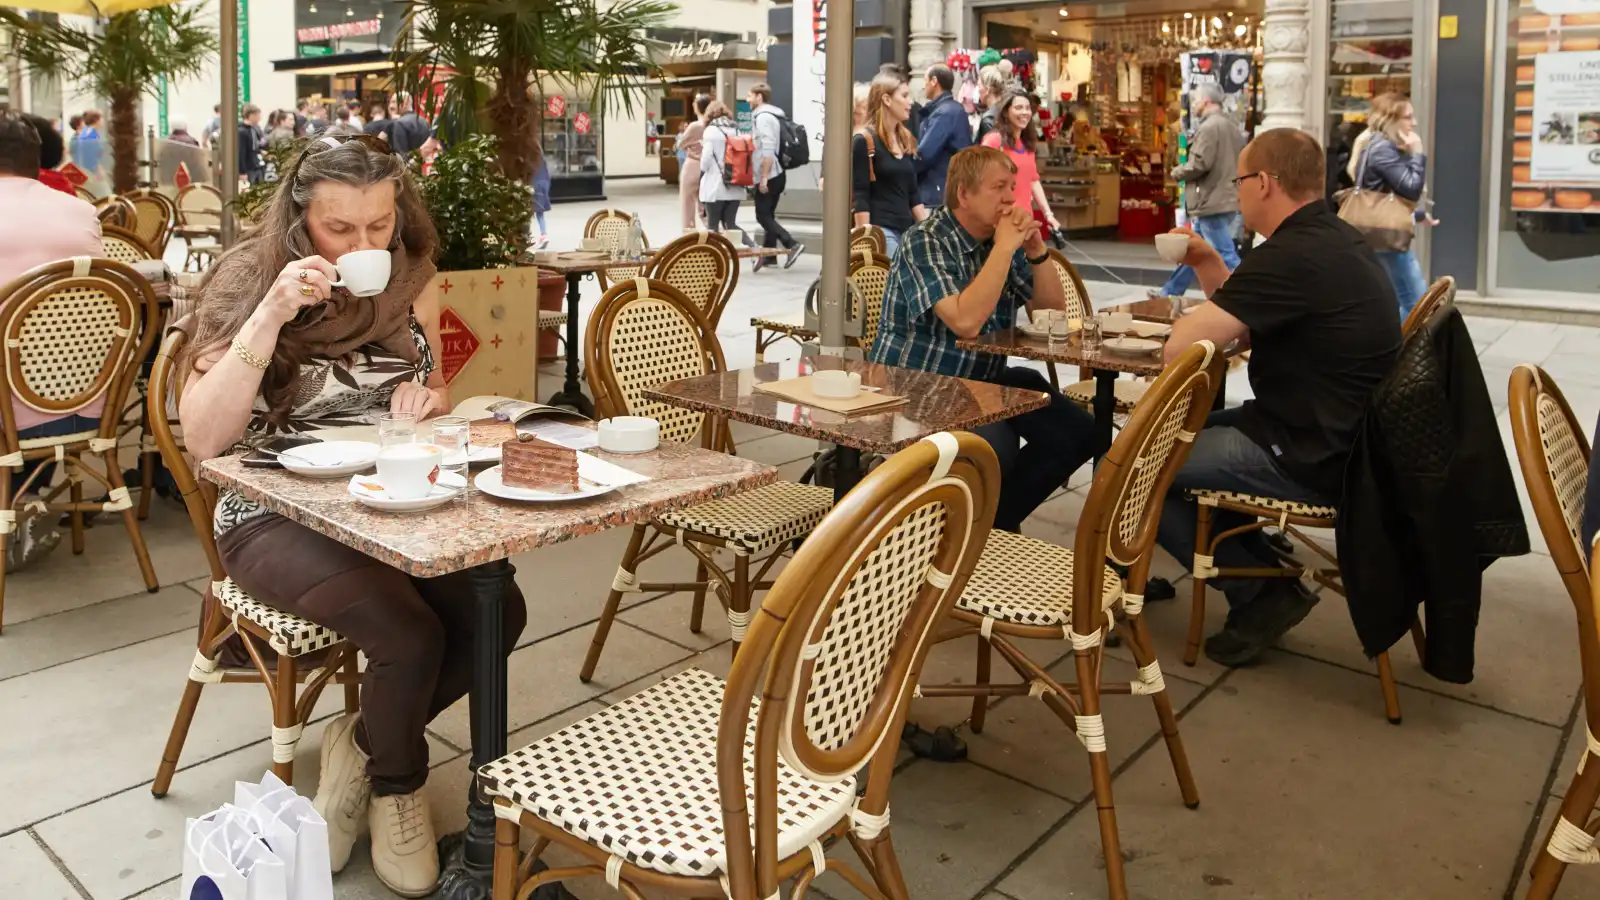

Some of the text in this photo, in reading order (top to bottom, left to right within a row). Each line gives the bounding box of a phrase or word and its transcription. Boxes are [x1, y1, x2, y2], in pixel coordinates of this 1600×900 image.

[669, 40, 694, 57] Hot
[696, 38, 724, 60] Dog
[441, 338, 473, 353] UKA
